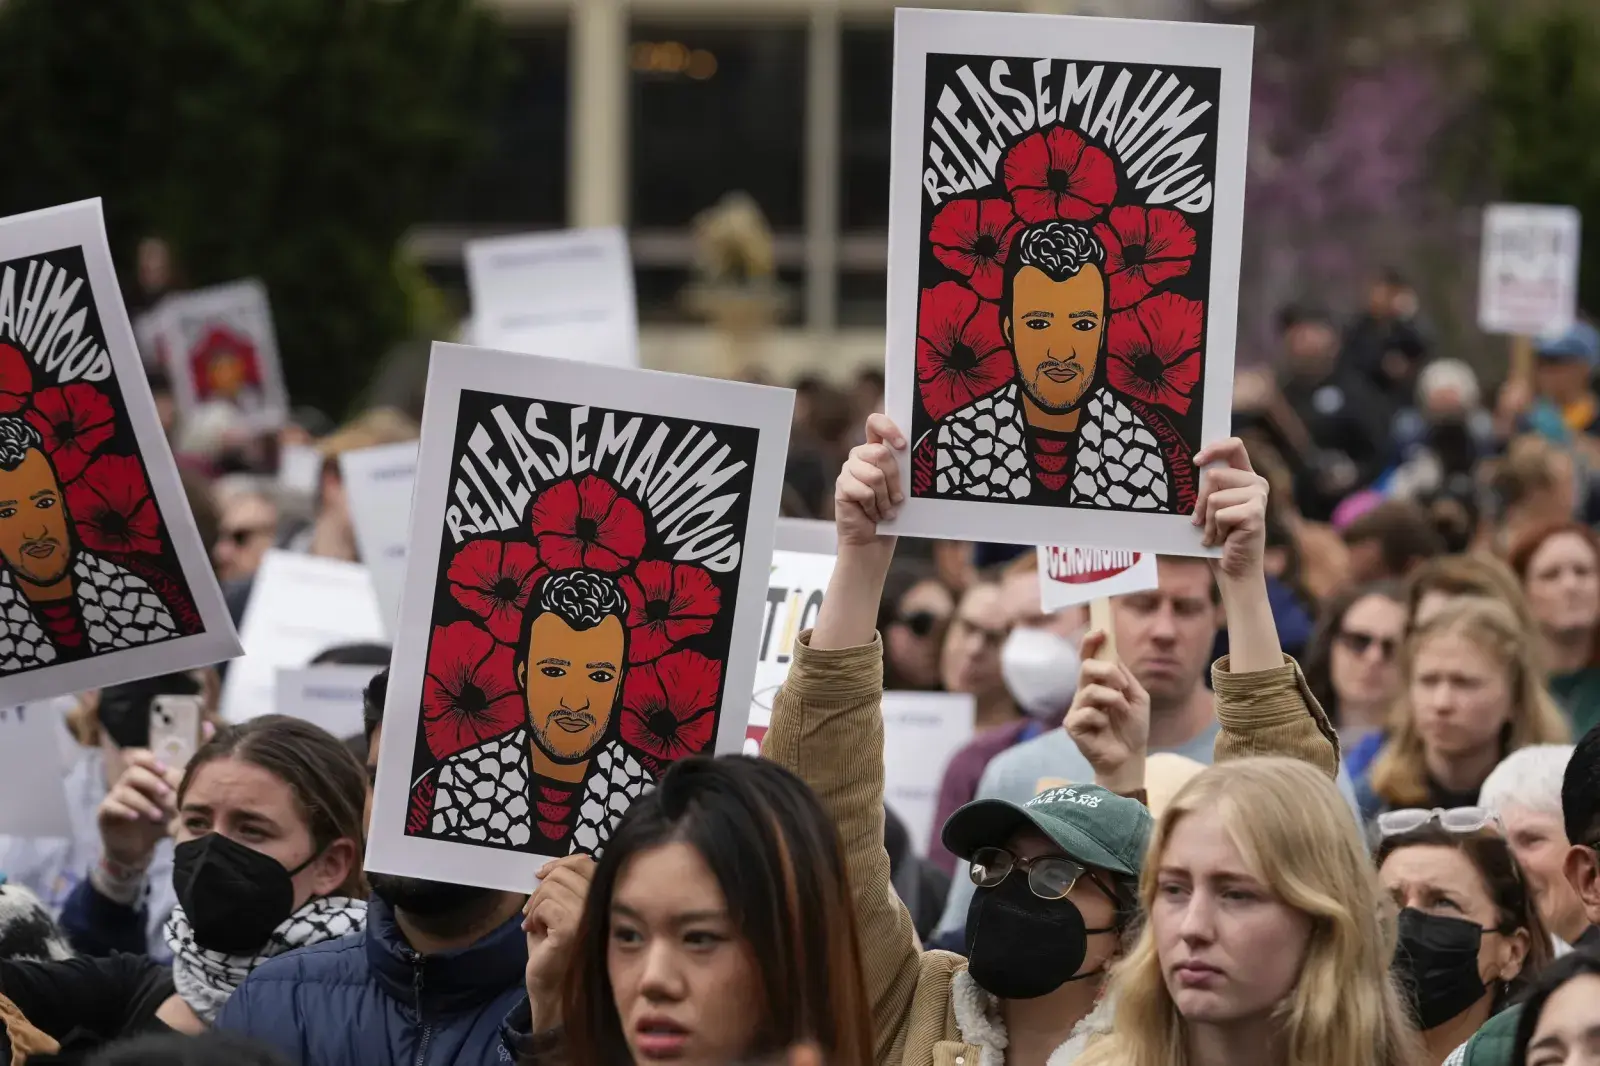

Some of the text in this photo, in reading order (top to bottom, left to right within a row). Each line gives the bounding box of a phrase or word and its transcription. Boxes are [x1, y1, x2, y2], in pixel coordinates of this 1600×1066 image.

[922, 58, 1212, 213] RELEASE MAHMOUD
[0, 259, 112, 383] AHMOUD
[445, 402, 748, 573] RELEASE MAHMOUD
[1164, 443, 1198, 514] STUDENTS
[1045, 787, 1103, 804] ARE ON
[1058, 795, 1098, 808] LAND
